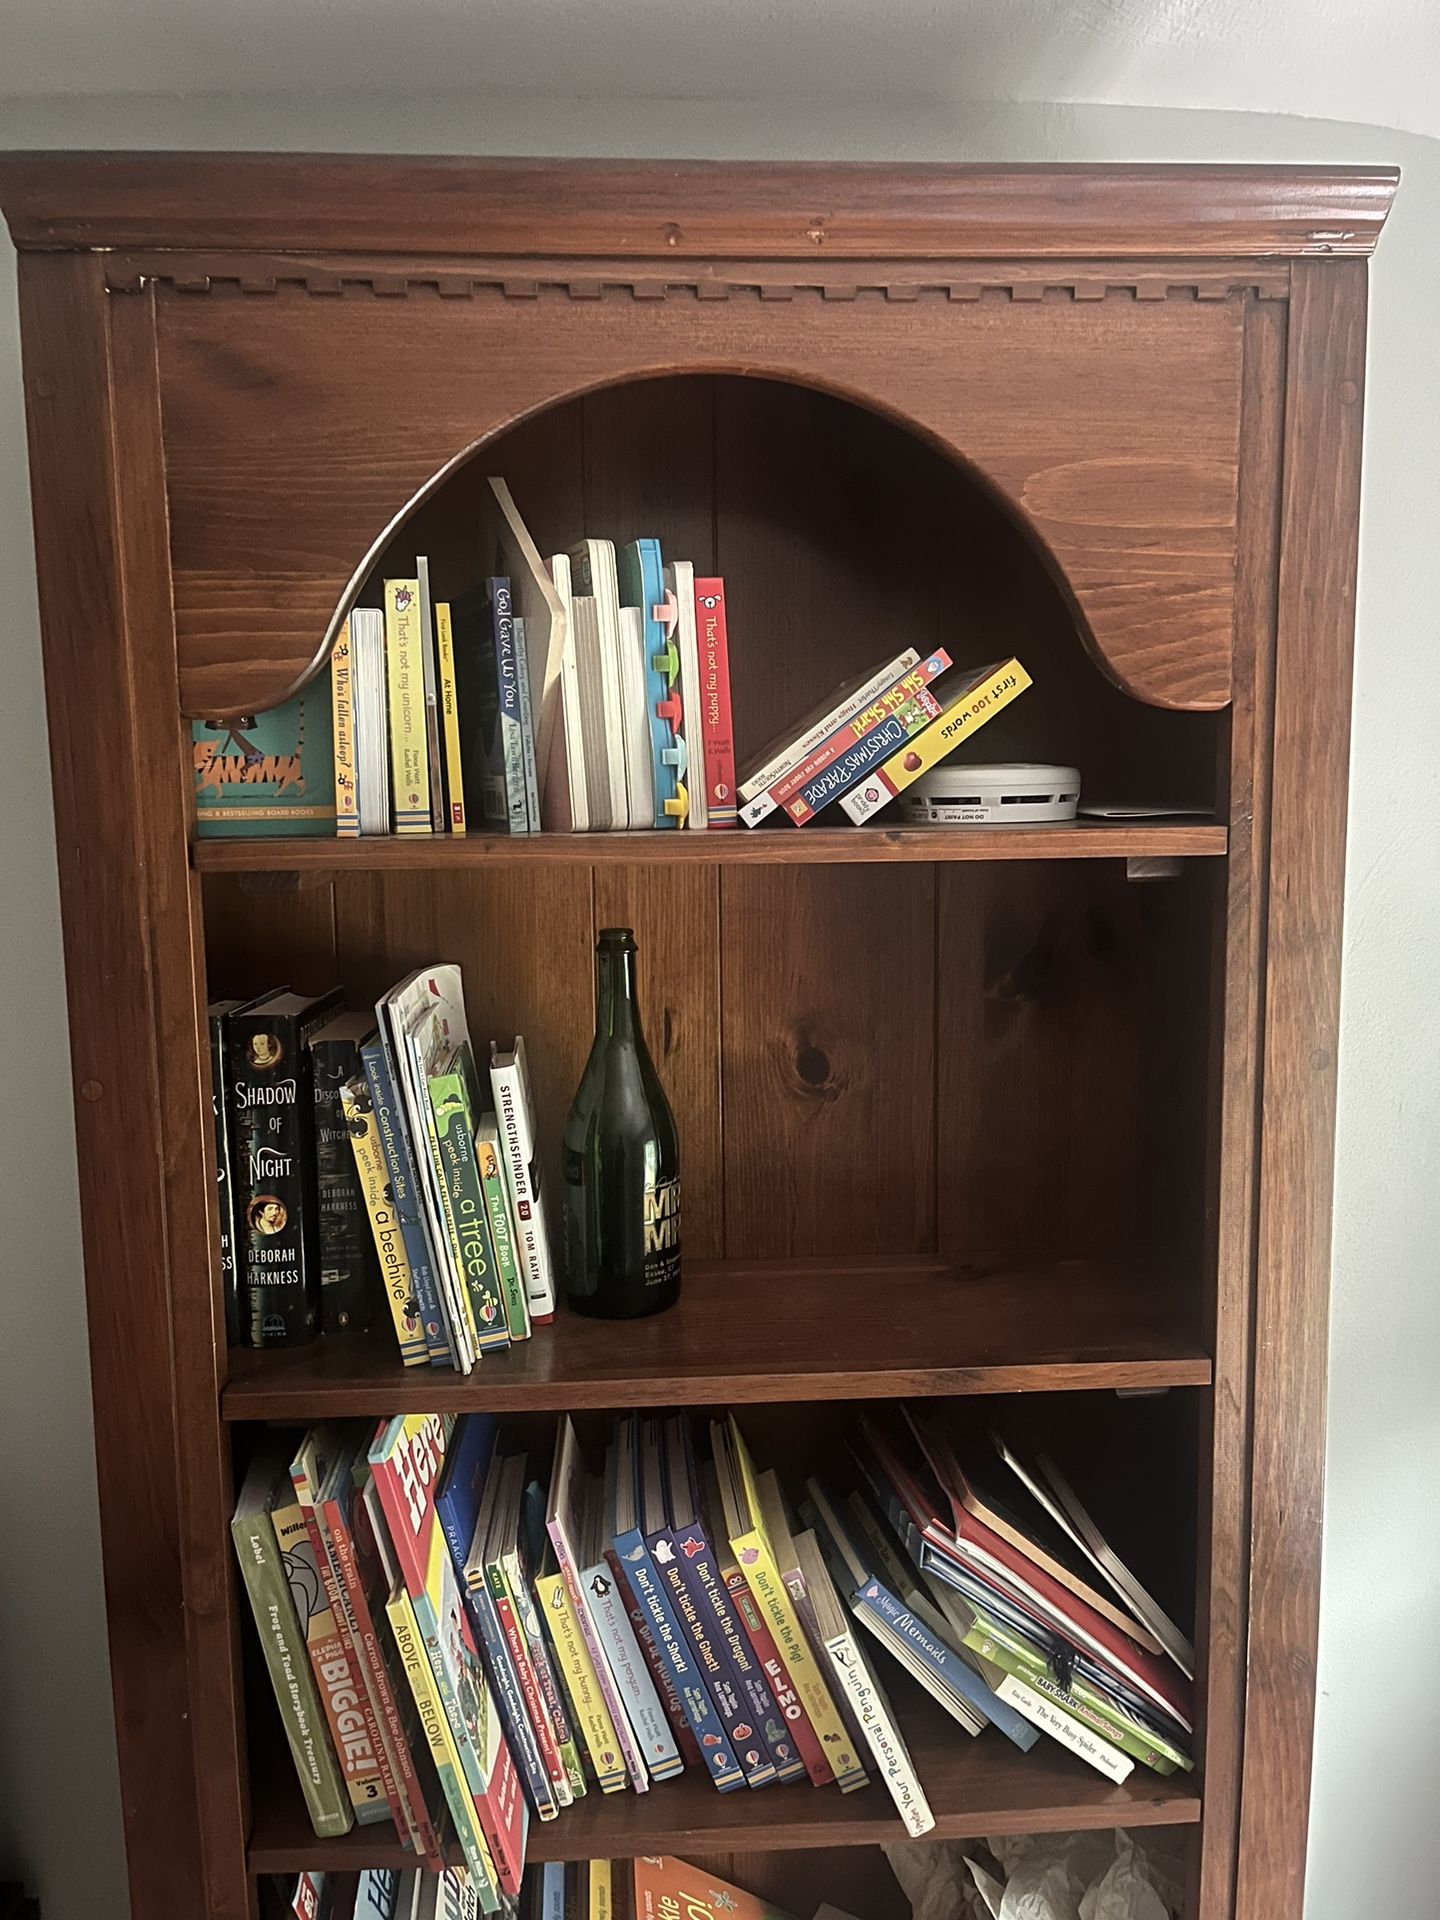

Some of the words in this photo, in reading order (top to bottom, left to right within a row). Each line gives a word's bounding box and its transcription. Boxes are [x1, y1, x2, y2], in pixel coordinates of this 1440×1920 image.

[496, 588, 510, 616] God
[398, 616, 408, 647] That's
[498, 618, 513, 656] Gave
[706, 616, 718, 647] That's
[400, 650, 410, 669] not
[502, 658, 514, 682] Us
[708, 650, 718, 669] not
[337, 668, 348, 698] Who's
[398, 672, 410, 694] my
[444, 678, 451, 690] At
[707, 672, 718, 690] my
[901, 670, 925, 694] Shh
[992, 675, 1016, 700] first
[504, 683, 518, 710] You
[882, 687, 905, 710] Shh
[972, 696, 992, 714] 100
[337, 698, 350, 726] fallen
[708, 692, 720, 732] puppy...
[824, 717, 838, 732] and
[838, 704, 856, 720] Hugs
[850, 704, 886, 739] Shark!
[941, 712, 972, 739] words
[337, 728, 351, 768] asleep?
[802, 730, 826, 748] Kisses
[845, 720, 902, 770] CHRISTMAS
[804, 767, 852, 806] PARADE
[266, 808, 289, 816] BOARD
[291, 808, 314, 816] BOOKS
[366, 1060, 381, 1083] Look
[235, 1078, 296, 1109] SHADOW
[314, 1088, 340, 1102] DISCO
[372, 1082, 387, 1107] inside
[270, 1116, 282, 1133] OF
[367, 1135, 386, 1172] usborne
[374, 1106, 405, 1175] Construction
[441, 1138, 460, 1167] peek
[453, 1124, 471, 1163] usborne
[497, 1085, 528, 1195] STRENGTHSFINDER
[519, 1203, 528, 1216] 2.0
[250, 1147, 292, 1186] NIGHT
[355, 1146, 375, 1178] peek
[322, 1188, 355, 1198] DEBORAH
[363, 1177, 384, 1208] inside
[393, 1175, 409, 1200] Sites
[447, 1166, 467, 1199] inside
[321, 1201, 358, 1212] HARKNESS
[459, 1198, 478, 1215] a
[489, 1195, 501, 1211] The
[374, 1210, 390, 1226] a
[492, 1213, 508, 1241] FOOT
[457, 1217, 494, 1278] tree
[524, 1230, 535, 1251] TOM
[248, 1248, 296, 1264] DEBORAH
[376, 1228, 412, 1301] beehive
[528, 1255, 540, 1280] RATH
[246, 1270, 299, 1285] HARKNESS
[392, 1414, 445, 1536] Here
[248, 1533, 266, 1565] Lobel
[332, 1528, 343, 1544] on
[337, 1543, 350, 1563] the
[342, 1561, 358, 1589] train
[634, 1566, 655, 1595] Don't
[665, 1566, 687, 1595] Don't
[695, 1560, 716, 1589] Don't
[753, 1570, 775, 1598] Don't
[599, 1598, 619, 1627] That's
[645, 1593, 667, 1624] tickle
[677, 1592, 699, 1623] tickle
[706, 1587, 728, 1617] tickle
[766, 1597, 788, 1626] tickle
[265, 1604, 284, 1631] Frog
[556, 1610, 575, 1639] That's
[689, 1621, 706, 1641] the
[718, 1616, 735, 1635] the
[274, 1631, 288, 1653] and
[610, 1627, 623, 1644] not
[658, 1623, 675, 1642] the
[778, 1624, 796, 1644] the
[891, 1609, 950, 1668] Mermaids
[362, 1632, 380, 1665] Carron
[429, 1649, 448, 1677] Here
[565, 1639, 579, 1658] not
[614, 1646, 627, 1662] my
[648, 1646, 660, 1660] DE
[665, 1640, 688, 1673] Shark!
[697, 1639, 720, 1672] Ghost!
[725, 1633, 751, 1673] Dragon!
[784, 1643, 805, 1665] Pig!
[280, 1653, 297, 1681] Toad
[569, 1658, 583, 1675] my
[371, 1664, 392, 1705] Brown
[394, 1623, 420, 1672] ABOVE
[418, 1699, 445, 1749] BELOW
[508, 1627, 520, 1648] Where
[519, 1660, 530, 1684] Baby's
[526, 1684, 541, 1722] Christmas
[536, 1724, 552, 1756] Present?
[574, 1674, 598, 1712] bunny...
[619, 1662, 644, 1704] penguin...
[652, 1660, 682, 1713] MUERTOS
[762, 1656, 803, 1722] ELMO
[844, 1667, 880, 1725] Penguin
[286, 1681, 312, 1736] Storybook
[320, 1657, 378, 1772] BIGGIE!
[384, 1705, 394, 1715] &
[1036, 1676, 1055, 1694] BABY
[1053, 1687, 1079, 1710] SHARK
[1078, 1704, 1102, 1726] Animal
[387, 1715, 400, 1736] Bee
[496, 1656, 509, 1690] Goodnight,
[507, 1690, 522, 1724] Goodnight,
[518, 1724, 532, 1762] Construction
[530, 1762, 538, 1776] Site
[552, 1709, 568, 1744] Calico!
[1035, 1704, 1050, 1719] The
[1046, 1714, 1064, 1731] Very
[1060, 1724, 1078, 1741] Busy
[1074, 1735, 1098, 1756] Spider
[363, 1707, 386, 1760] CAROLINA
[300, 1737, 324, 1786] Treasury
[392, 1735, 413, 1779] Johnson
[867, 1721, 902, 1779] Personal
[366, 1786, 378, 1798] 3
[893, 1778, 914, 1808] Your
